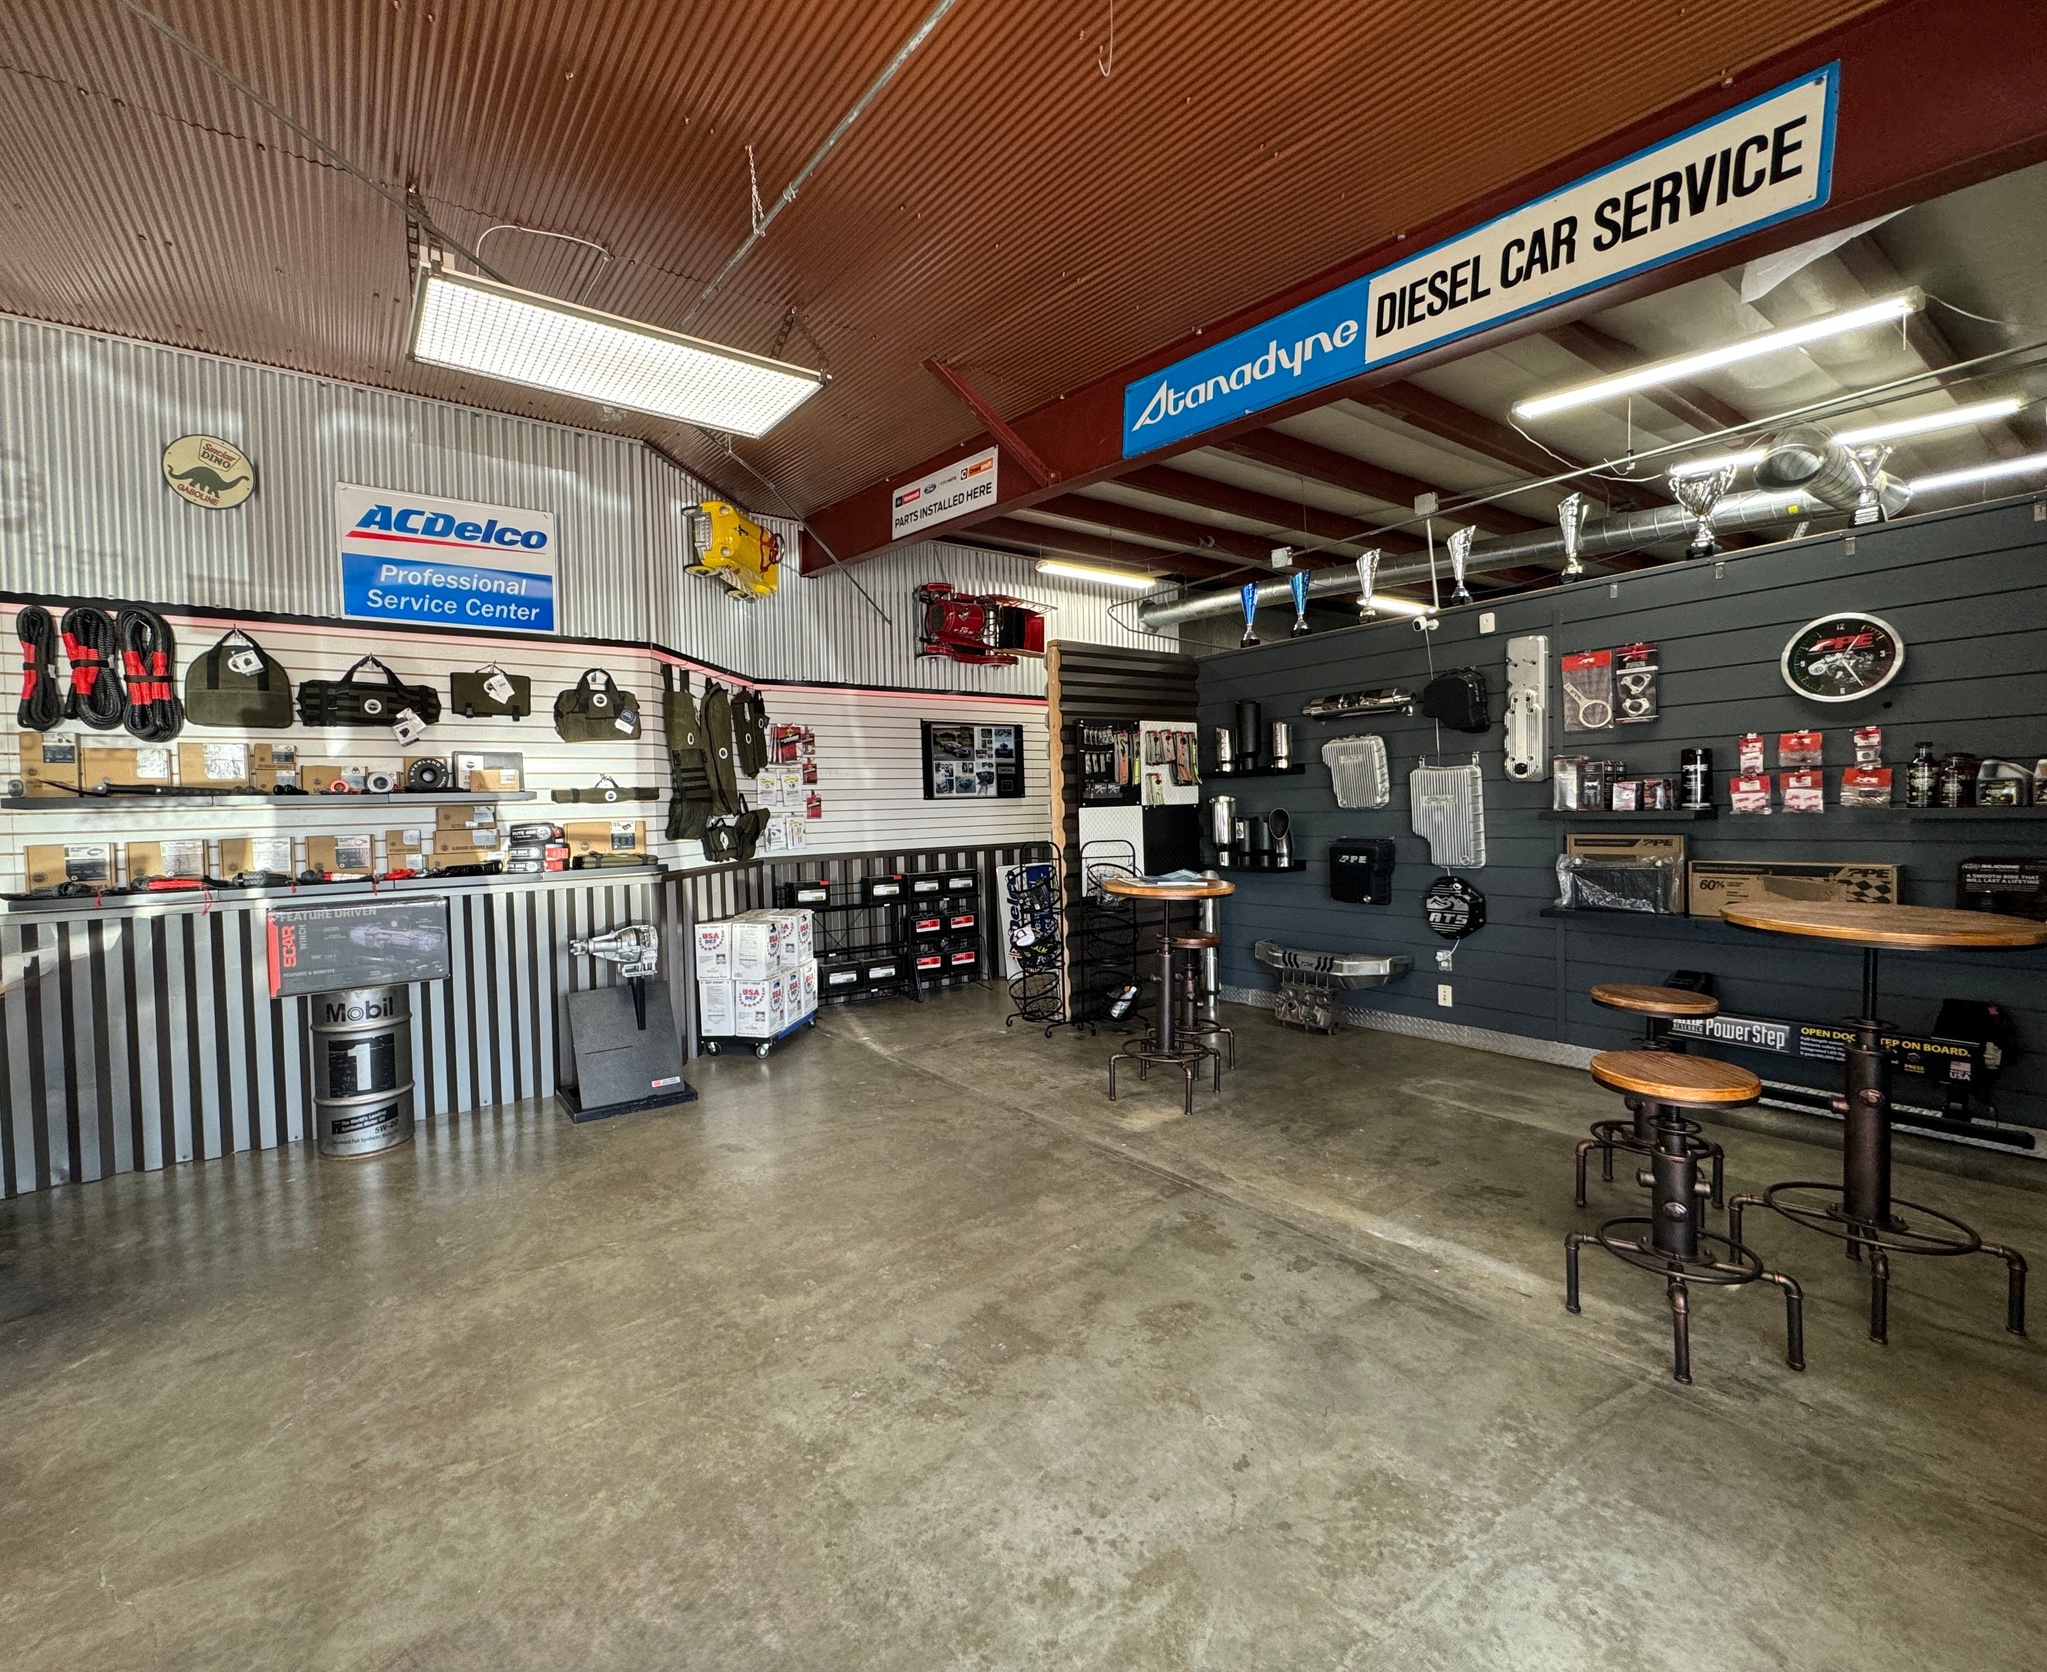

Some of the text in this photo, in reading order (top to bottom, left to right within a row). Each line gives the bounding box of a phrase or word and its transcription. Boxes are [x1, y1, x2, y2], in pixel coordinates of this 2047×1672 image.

[1375, 114, 1808, 338] DIESEL CAR SERVICE
[1131, 319, 1359, 432] Stanadyne
[201, 450, 231, 469] DINO
[202, 443, 236, 462] Sinclair
[177, 483, 220, 507] GASOLINE
[895, 481, 992, 530] PARTS INSTALLED HERE
[355, 504, 548, 549] ACDelco
[380, 563, 527, 596] Professional
[366, 589, 540, 621] Service Center
[1808, 632, 1874, 652] PPE
[410, 759, 441, 776] OVERLAND
[1643, 838, 1674, 847] PPE
[1338, 854, 1367, 863] PPE
[1849, 868, 1891, 879] PPE
[1699, 879, 1726, 891] 60%
[280, 907, 378, 923] FEATURE DRIVEN
[1429, 912, 1469, 925] ATS
[702, 932, 720, 940] USA
[800, 923, 809, 933] USA
[298, 924, 308, 950] WINCH
[769, 934, 778, 944] USA
[281, 925, 297, 968] SCAR
[742, 988, 760, 996] USA
[772, 988, 781, 999] USA
[789, 981, 798, 991] USA
[326, 996, 394, 1023] Mobil
[1673, 1022, 1703, 1032] RESEARCH
[1800, 1027, 1830, 1038] OPEN
[1901, 1040, 1921, 1050] ON
[1923, 1043, 1971, 1058] BOARD.
[347, 1043, 373, 1092] 1
[1949, 1072, 1971, 1081] USA
[350, 1115, 369, 1123] World's
[369, 1110, 387, 1119] Leading
[341, 1123, 363, 1132] Synthetic
[363, 1119, 378, 1127] Motor
[375, 1118, 399, 1134] 5W-20
[361, 1134, 382, 1143] Synthetic
